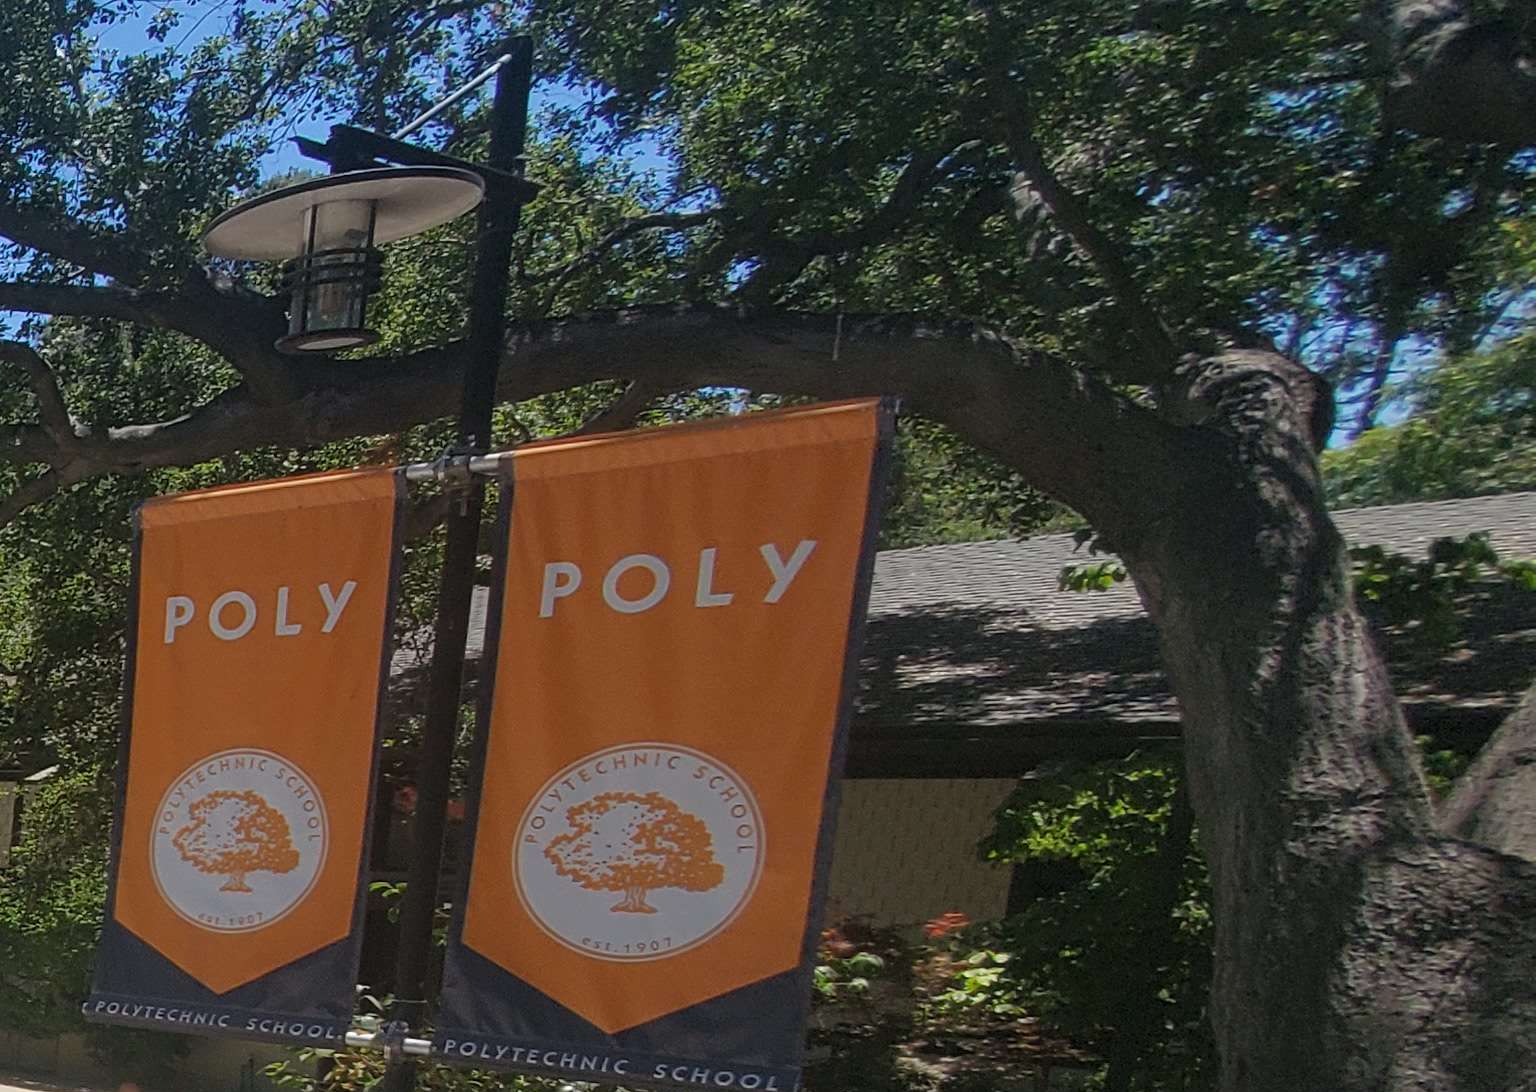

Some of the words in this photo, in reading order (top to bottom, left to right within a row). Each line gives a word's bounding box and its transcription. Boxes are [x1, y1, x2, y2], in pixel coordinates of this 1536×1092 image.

[163, 580, 357, 643] POLY
[538, 539, 817, 618] POLY
[159, 757, 268, 834] POLYTECHNIC
[275, 768, 320, 842] SCHOOL
[525, 753, 680, 844] POLYTECHNIC
[692, 765, 754, 854] SCHOOL
[95, 1000, 230, 1027] POLYTECHNIC
[246, 1018, 335, 1039] SCHOOL
[443, 1039, 630, 1074] POLYTECHNIC
[652, 1063, 779, 1092] SCHOOL
